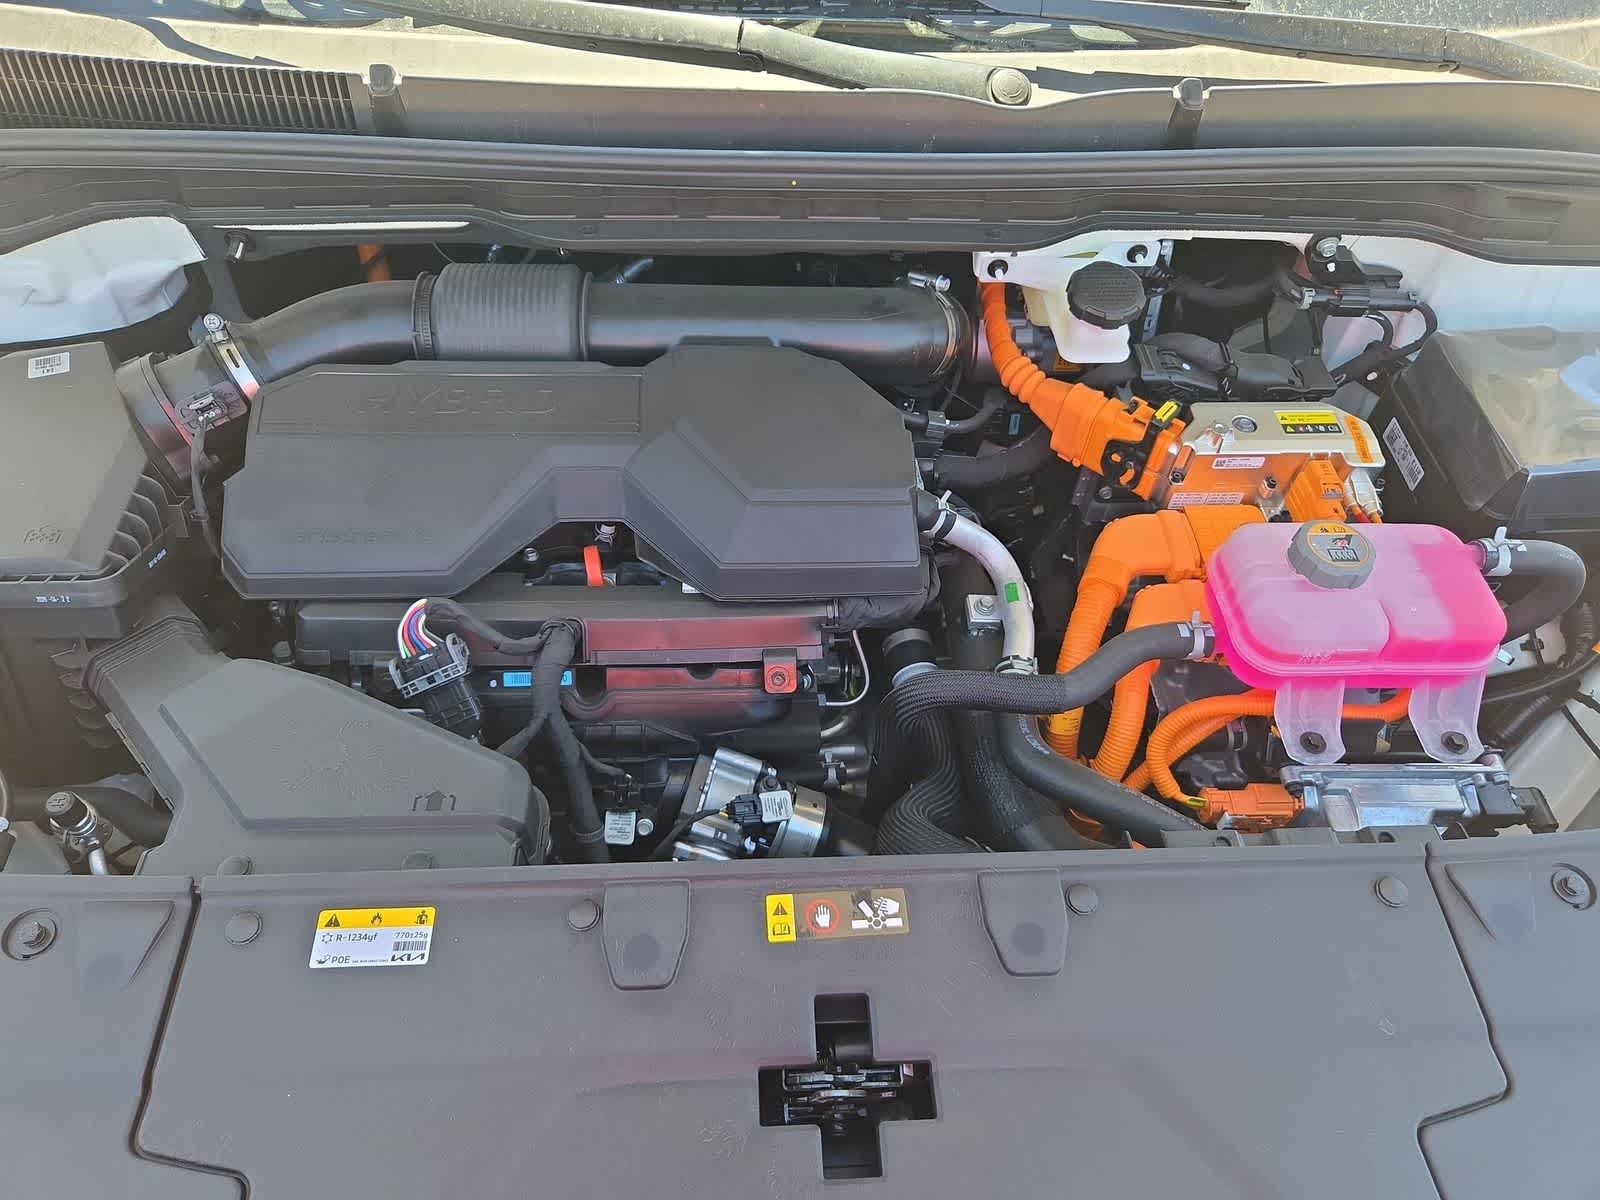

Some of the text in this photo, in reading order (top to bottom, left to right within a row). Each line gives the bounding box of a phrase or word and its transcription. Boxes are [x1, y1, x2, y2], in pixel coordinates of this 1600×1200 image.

[350, 386, 558, 414] HYBRD
[331, 956, 351, 964] POE
[391, 953, 425, 962] KIA
